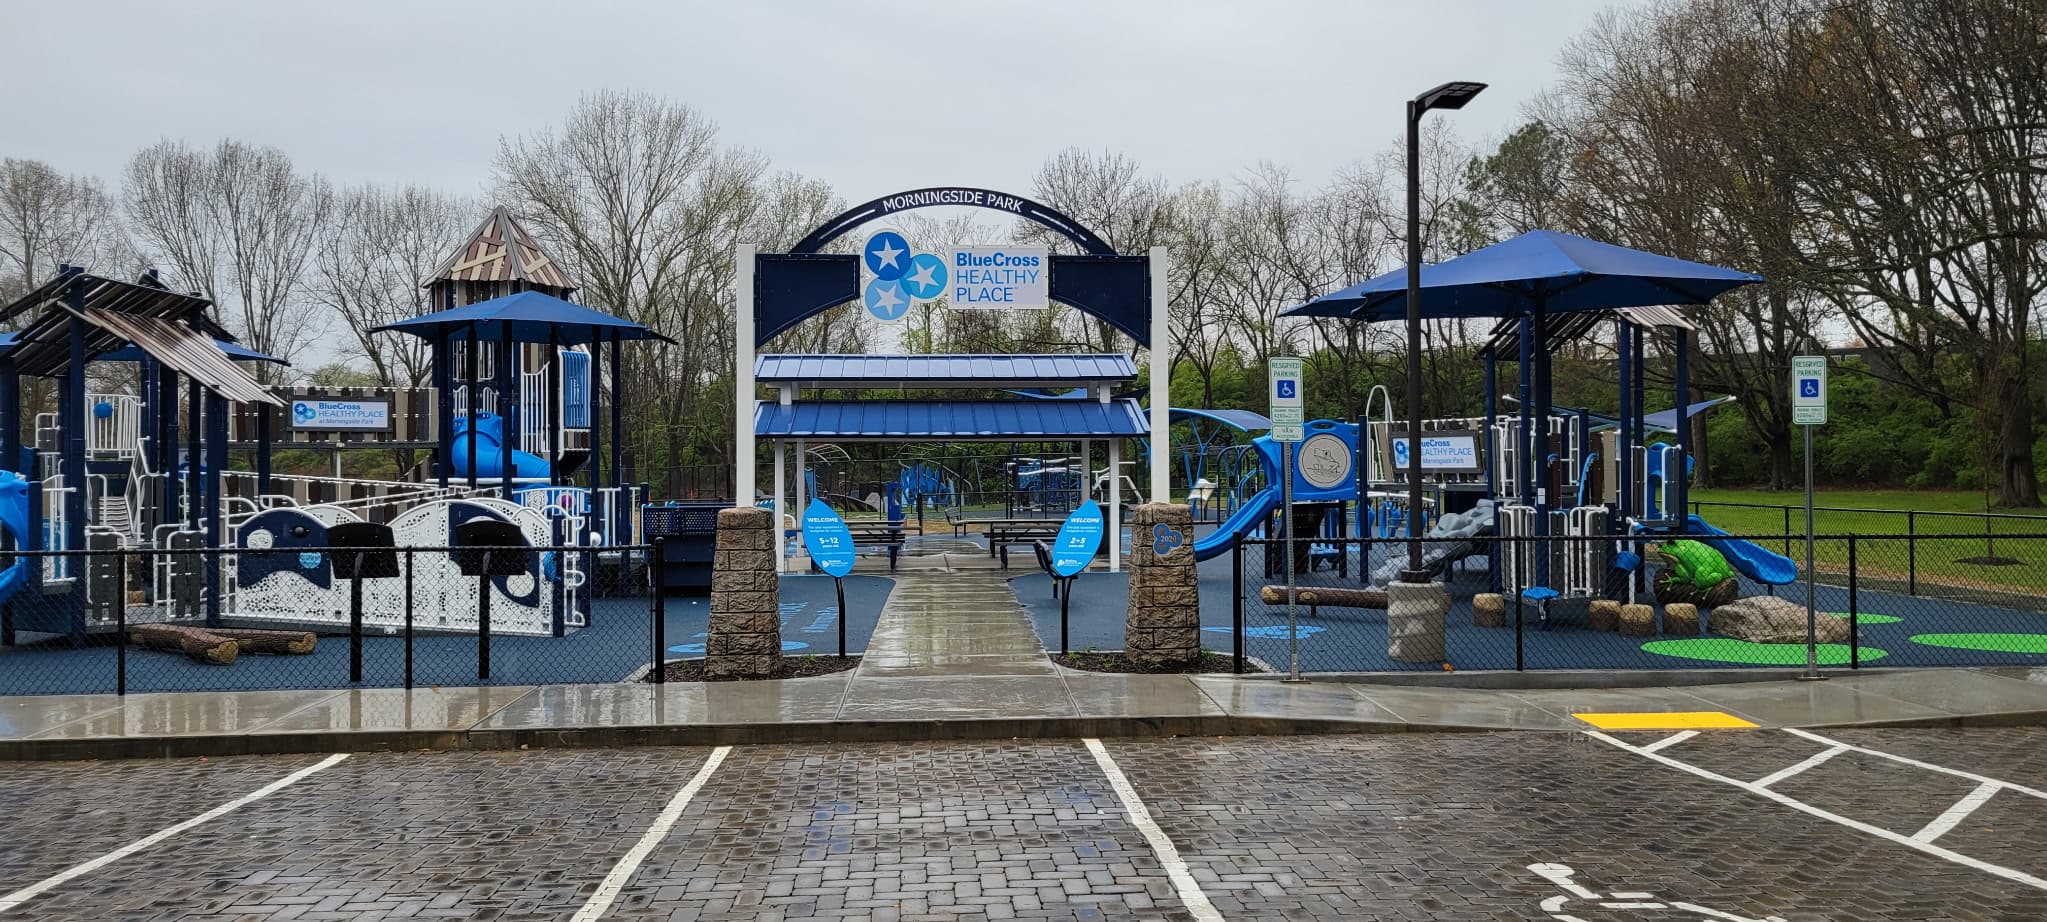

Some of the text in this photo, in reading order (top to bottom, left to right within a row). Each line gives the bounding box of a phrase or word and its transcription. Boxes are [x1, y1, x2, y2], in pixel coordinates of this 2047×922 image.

[882, 190, 1024, 213] MORNINGSIDE PARK
[956, 252, 1040, 267] BlueCross
[956, 269, 1040, 284] HEALTHY
[956, 287, 1014, 302] PLACE
[1795, 360, 1824, 368] RESERVED
[318, 402, 361, 410] BlueCross
[318, 410, 385, 418] HEALTHY PLACE
[1448, 447, 1473, 456] PLACE
